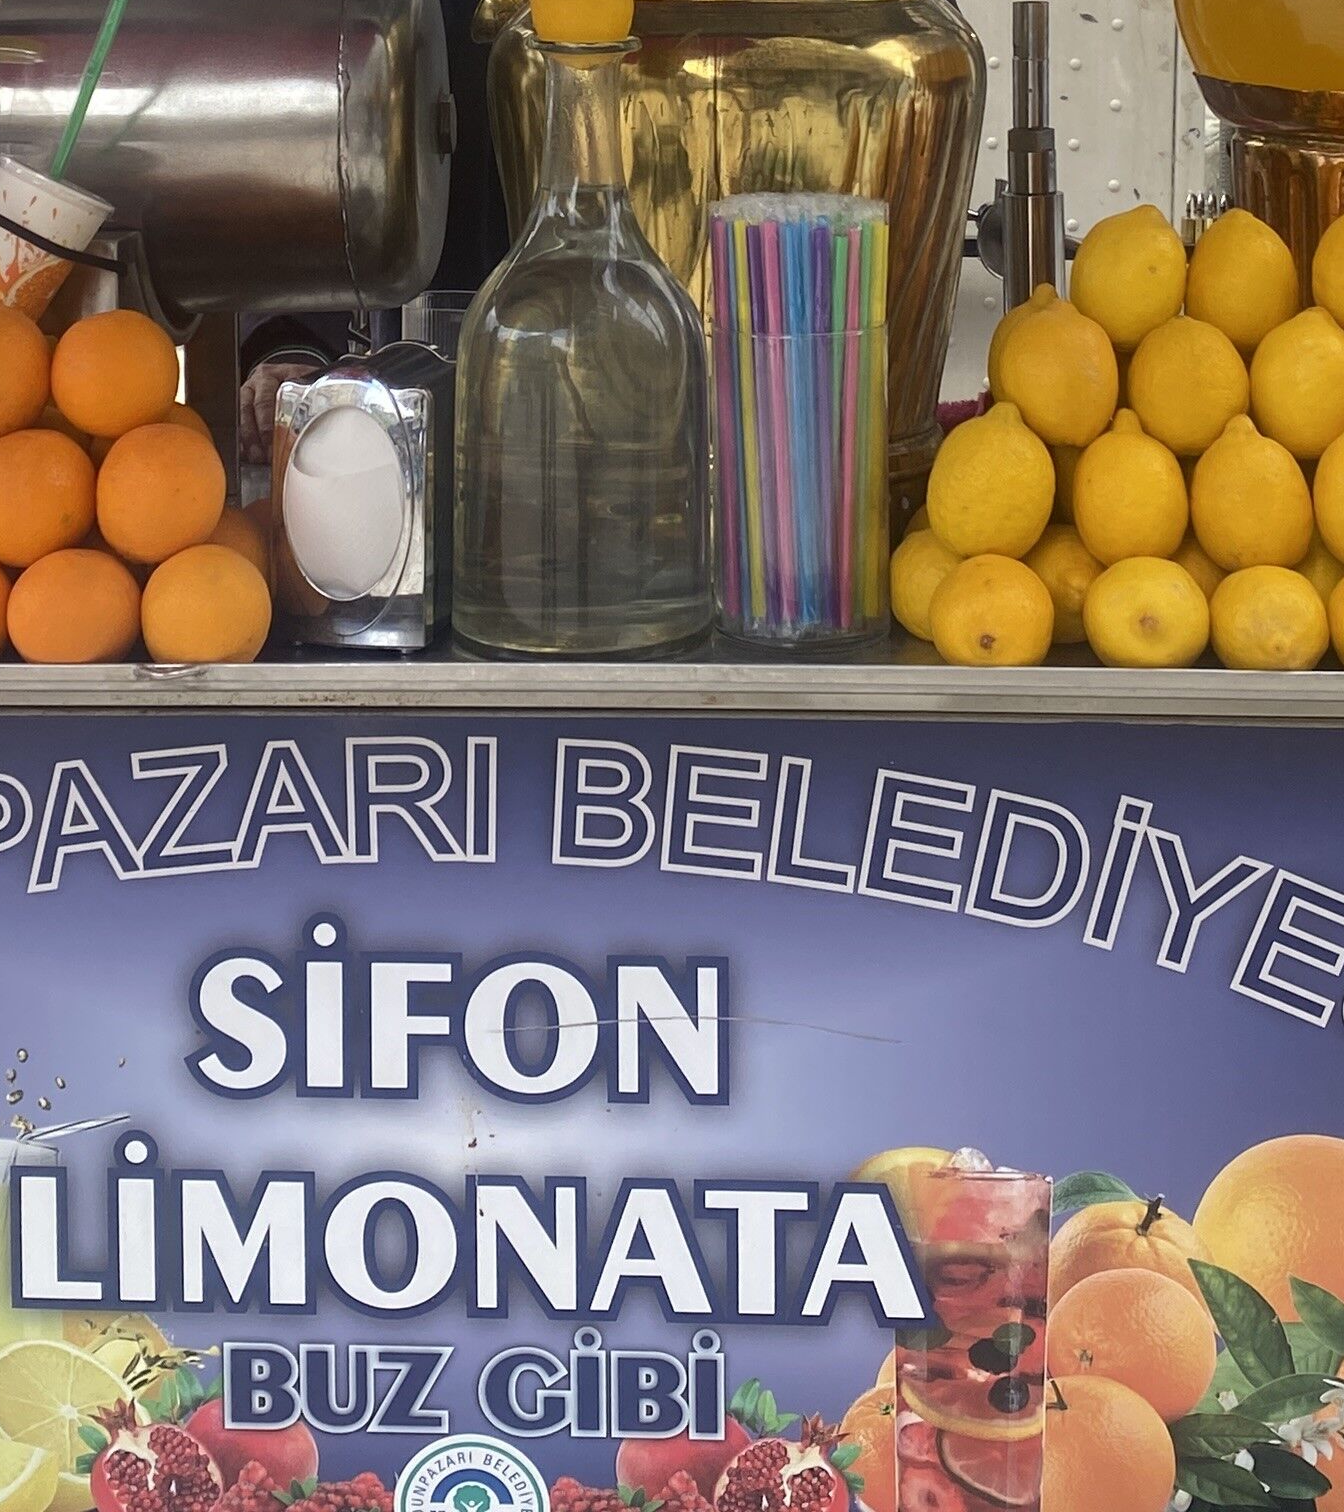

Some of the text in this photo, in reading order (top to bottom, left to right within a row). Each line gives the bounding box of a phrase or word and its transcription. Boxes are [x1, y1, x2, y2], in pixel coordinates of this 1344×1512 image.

[193, 918, 725, 1099] SİFON
[16, 1136, 928, 1323] LİMONATA
[222, 1326, 726, 1441] BUZ GİBİ
